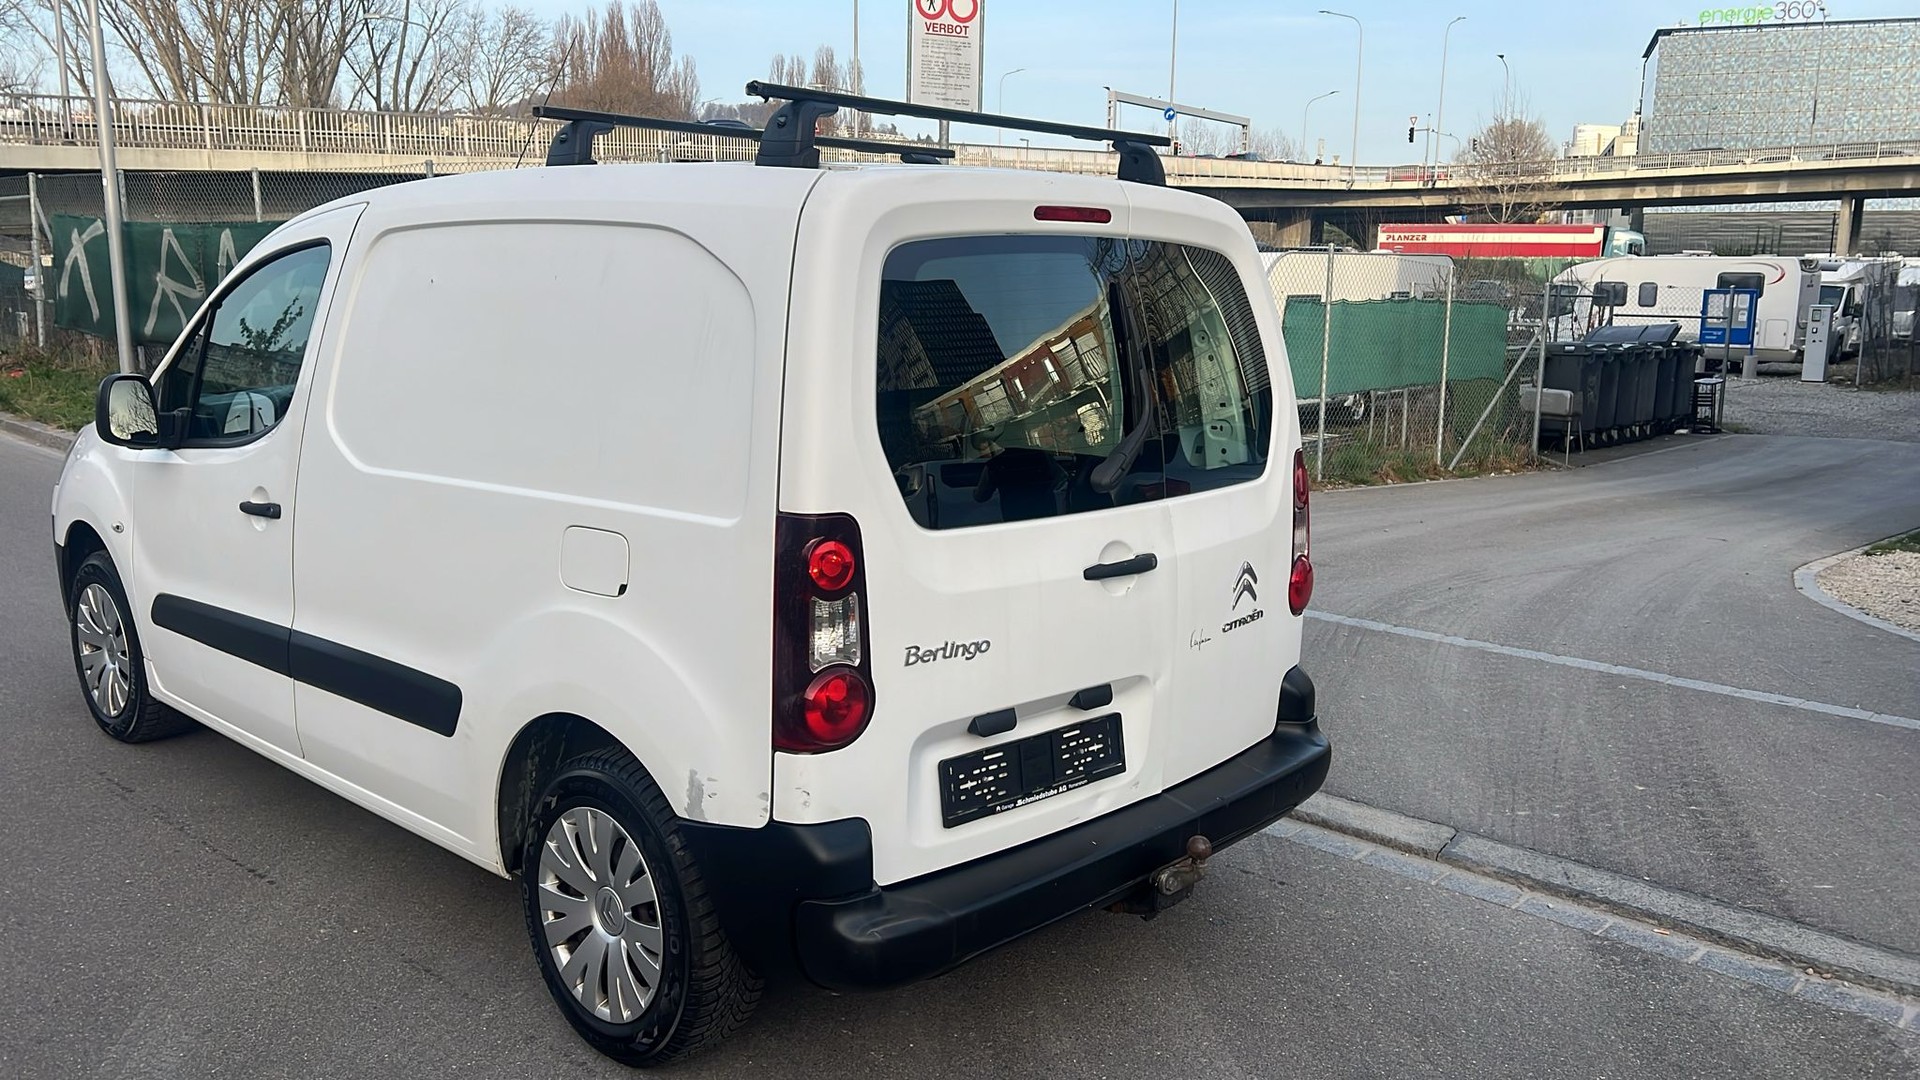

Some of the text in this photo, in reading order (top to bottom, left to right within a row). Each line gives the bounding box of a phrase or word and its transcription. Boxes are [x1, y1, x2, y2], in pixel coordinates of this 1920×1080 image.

[924, 21, 970, 36] VERBOT
[1385, 234, 1428, 242] PLANZER
[903, 637, 991, 667] Berlingo
